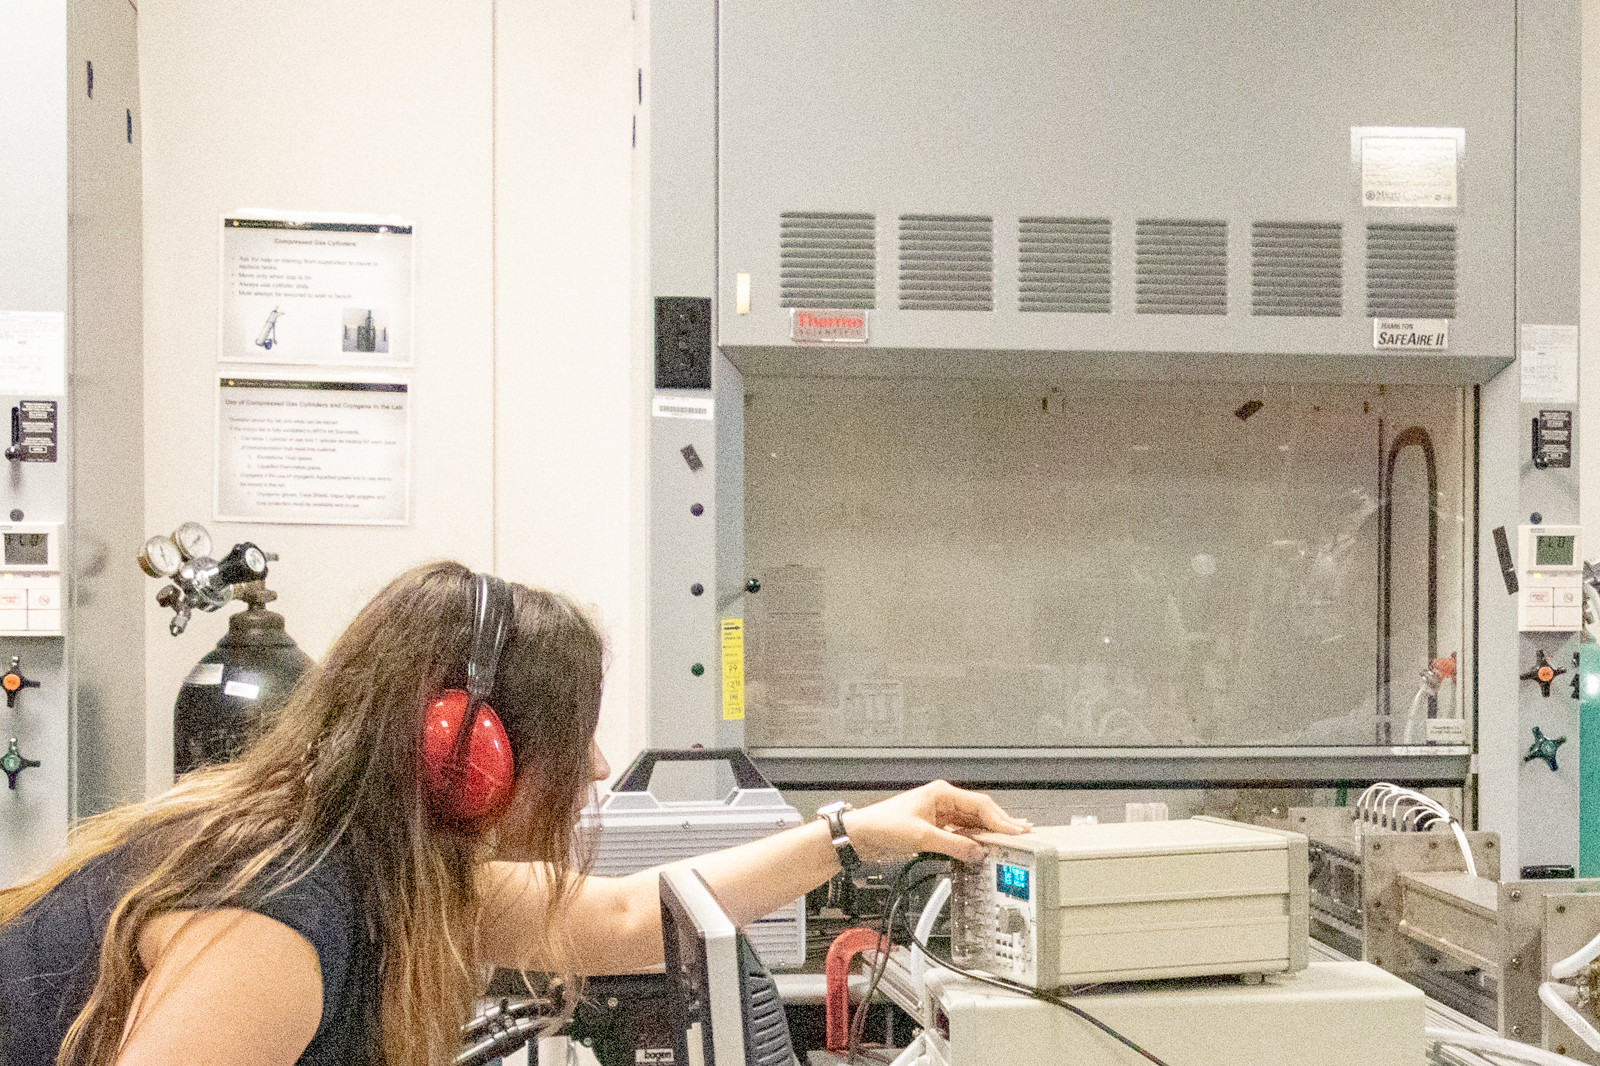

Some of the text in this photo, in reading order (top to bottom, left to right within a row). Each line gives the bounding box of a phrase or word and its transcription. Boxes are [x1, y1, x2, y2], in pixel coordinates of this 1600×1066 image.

[274, 238, 312, 247] Compressed
[328, 240, 356, 249] Cylinders
[797, 313, 863, 328] Thermo
[246, 400, 284, 408] Compressed
[299, 401, 328, 410] Cylinders
[644, 1050, 672, 1062] bogen
